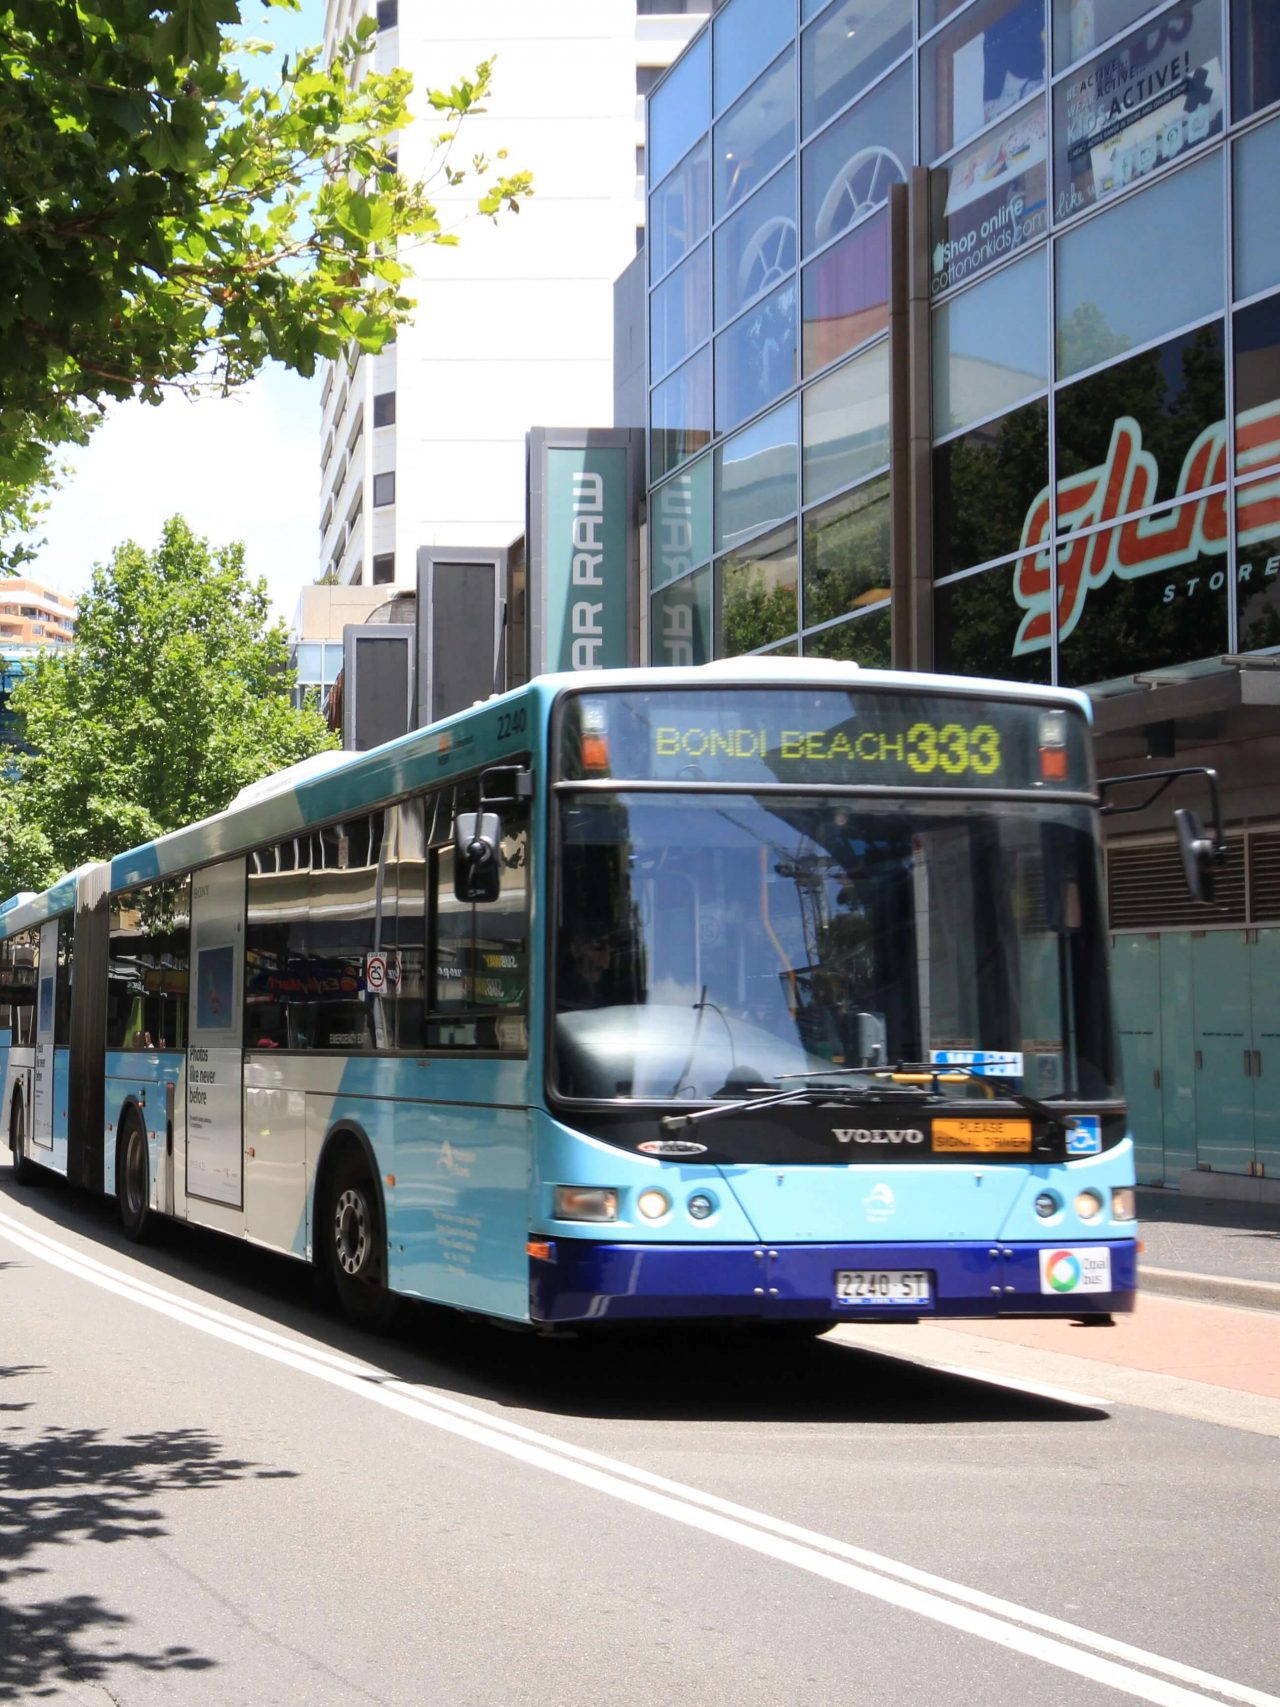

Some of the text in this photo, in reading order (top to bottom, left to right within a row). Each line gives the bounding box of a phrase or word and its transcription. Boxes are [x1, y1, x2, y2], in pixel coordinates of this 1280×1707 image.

[1108, 50, 1190, 120] ACTIVE!
[1055, 182, 1085, 218] like
[980, 196, 1024, 237] online
[572, 472, 603, 586] RAW
[1162, 555, 1280, 603] STORE
[497, 708, 527, 740] 2240
[655, 723, 1002, 775] BONDI BEACH 333
[189, 1045, 208, 1061] Photos
[189, 1065, 216, 1084] like never
[189, 1086, 207, 1104] before
[831, 1128, 924, 1144] VOLVO
[959, 1121, 1004, 1133] PLEASE
[935, 1136, 977, 1149] SIGNAL
[842, 1274, 924, 1296] 2240 ST
